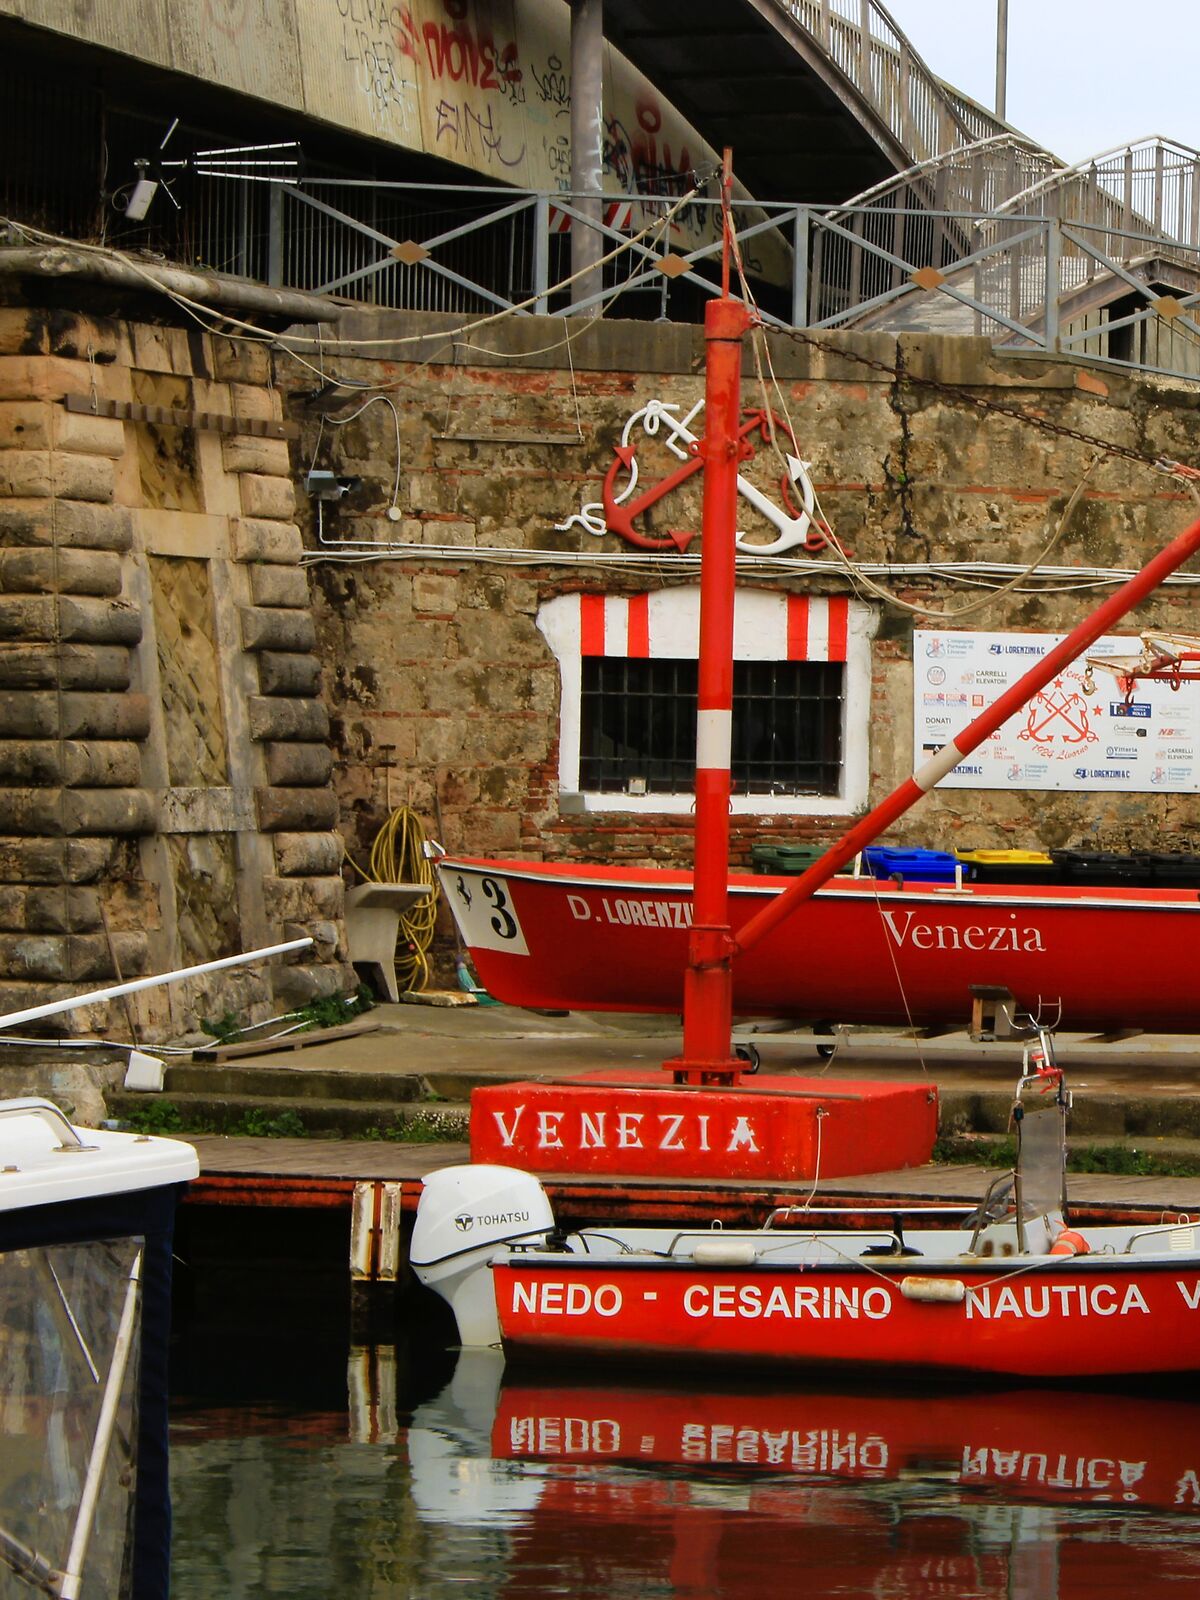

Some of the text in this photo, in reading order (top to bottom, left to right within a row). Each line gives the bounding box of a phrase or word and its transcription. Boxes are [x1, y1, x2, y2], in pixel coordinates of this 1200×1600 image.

[1031, 744, 1055, 759] 1924
[481, 878, 518, 940] 3
[602, 898, 694, 929] LORENZI
[878, 910, 1047, 952] Venezia
[492, 1104, 761, 1153] VENEZIA
[477, 1211, 530, 1226] TOHATSU
[512, 1282, 623, 1317] NEDO
[683, 1284, 892, 1321] CESARINO
[965, 1283, 1150, 1319] NAUTICA
